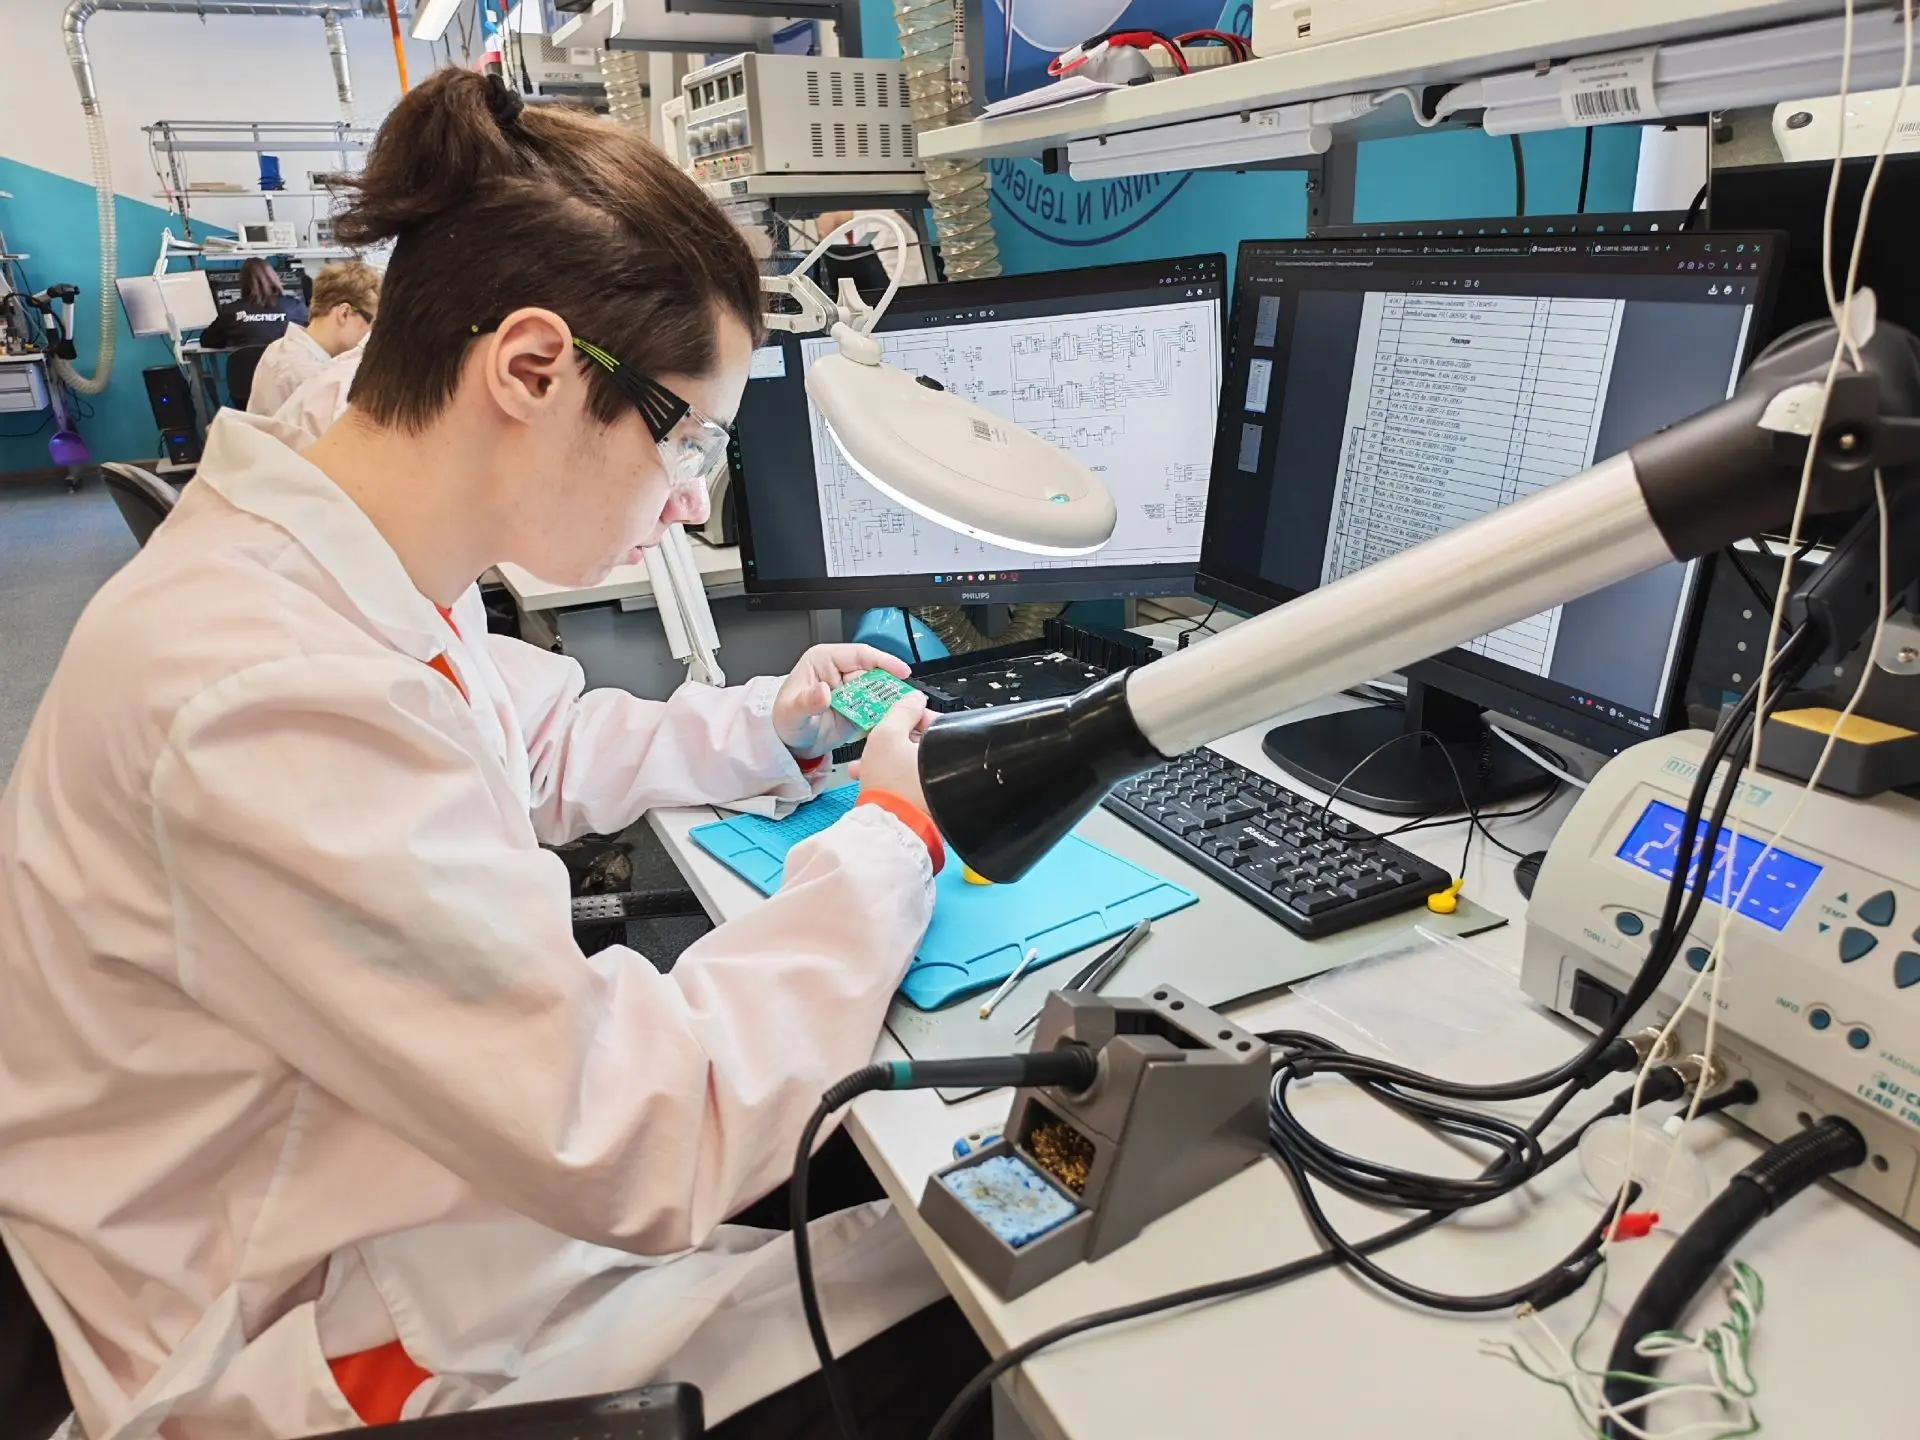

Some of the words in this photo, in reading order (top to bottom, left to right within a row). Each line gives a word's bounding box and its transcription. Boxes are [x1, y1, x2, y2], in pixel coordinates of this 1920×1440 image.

[962, 592, 990, 600] PHILIPS
[1821, 904, 1848, 921] TEMP
[1775, 996, 1800, 1014] INFO
[1856, 1084, 1895, 1110] LEAD
